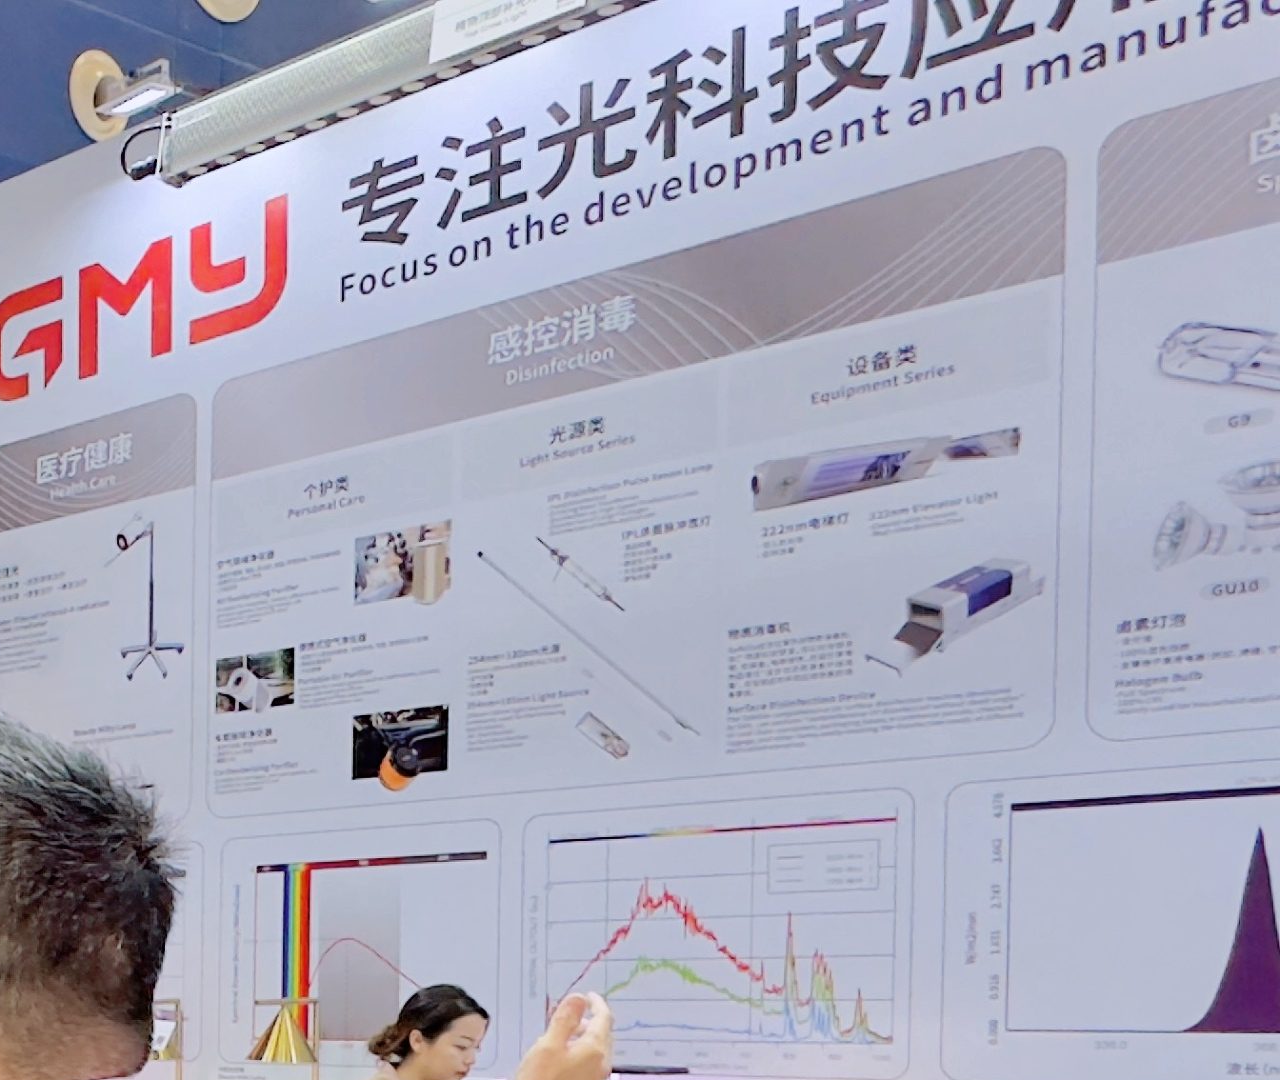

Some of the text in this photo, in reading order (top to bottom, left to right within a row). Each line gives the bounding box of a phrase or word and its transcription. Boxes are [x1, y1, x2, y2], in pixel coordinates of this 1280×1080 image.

[342, 0, 1152, 245] 专注光科技应
[341, 250, 439, 302] Focus
[448, 232, 491, 268] on
[506, 205, 569, 250] the
[582, 104, 889, 225] development
[908, 63, 1004, 126] and
[488, 295, 637, 366] 感控消毒
[505, 345, 615, 386] Disinfection
[847, 344, 918, 377] 设备类
[810, 363, 956, 405] Equipment Series
[549, 417, 605, 445] 光源类
[37, 432, 133, 484] 医疗健康
[519, 433, 636, 469] Light Source Series
[50, 475, 117, 500] Health Care
[288, 495, 366, 519] Personal Care
[1212, 580, 1259, 597] GU10
